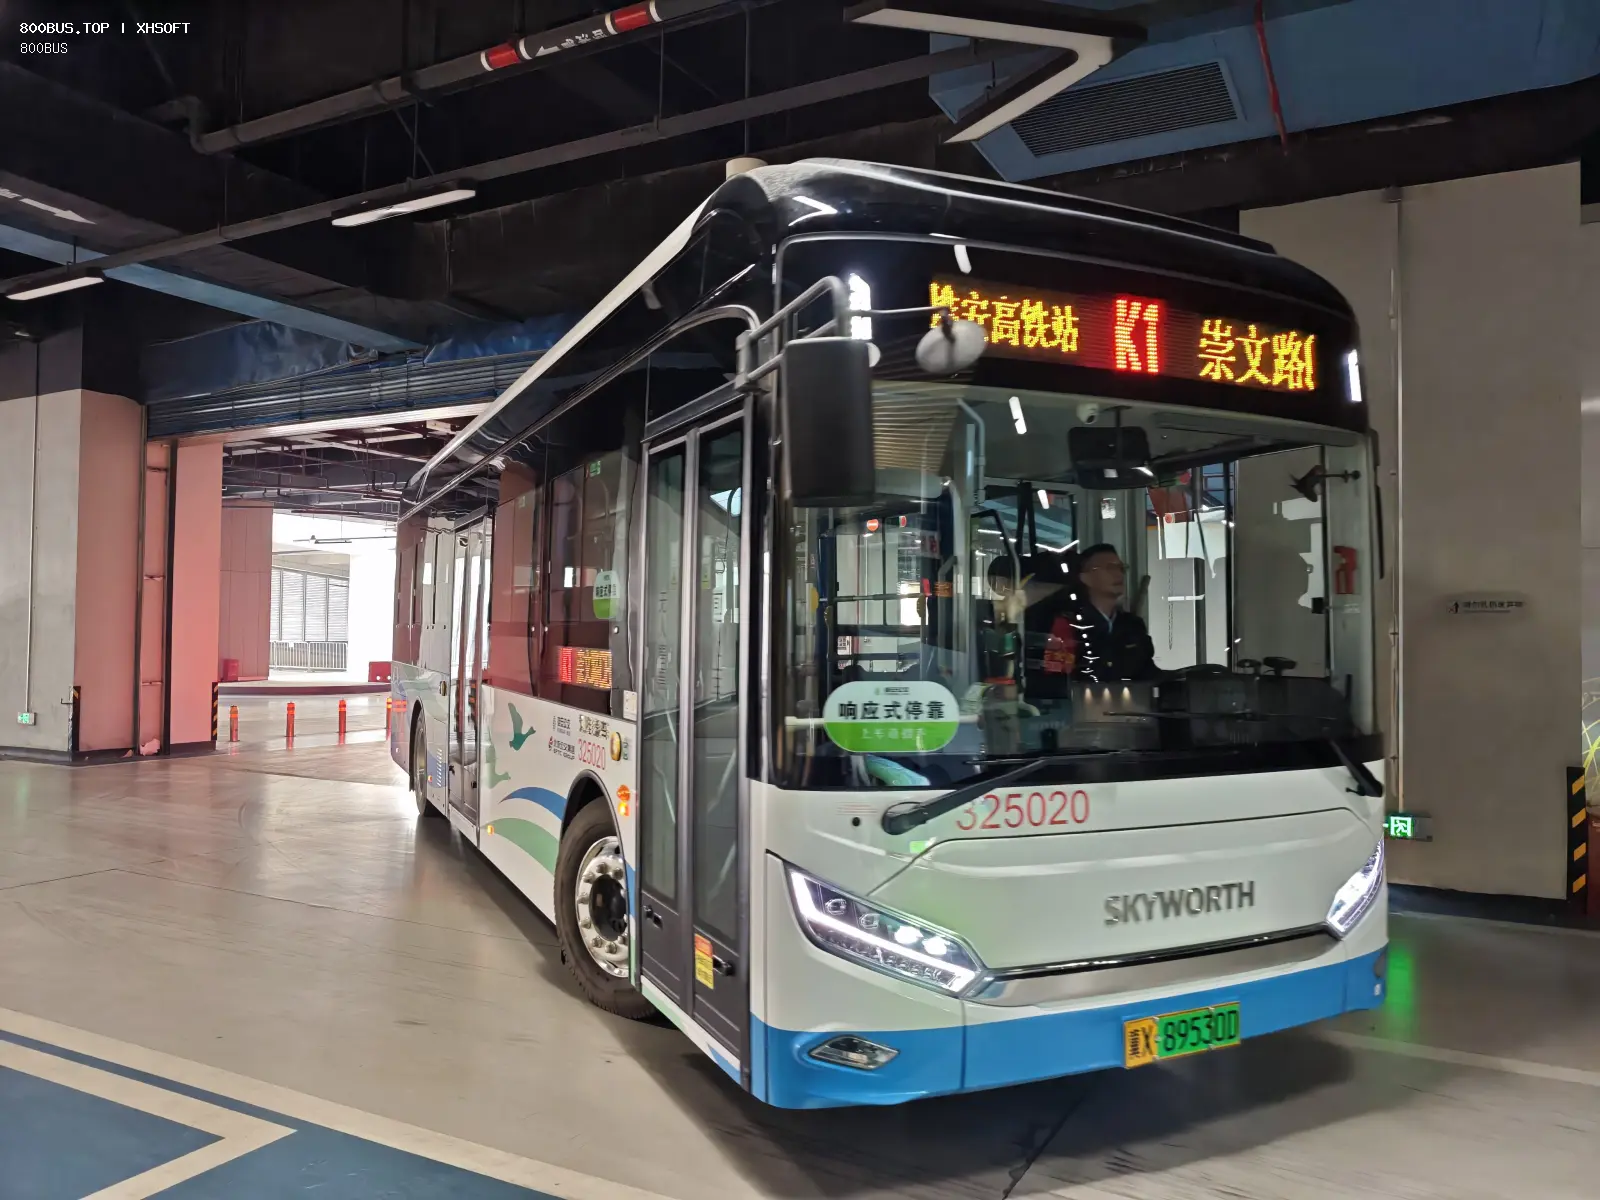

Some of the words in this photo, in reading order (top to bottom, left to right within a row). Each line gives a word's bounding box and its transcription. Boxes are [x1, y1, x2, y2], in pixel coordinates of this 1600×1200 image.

[1115, 299, 1159, 373] K1
[838, 701, 945, 720] 响应式停靠
[577, 738, 606, 770] 325020
[956, 790, 1090, 831] 325020
[1104, 881, 1256, 926] SKYWORTH
